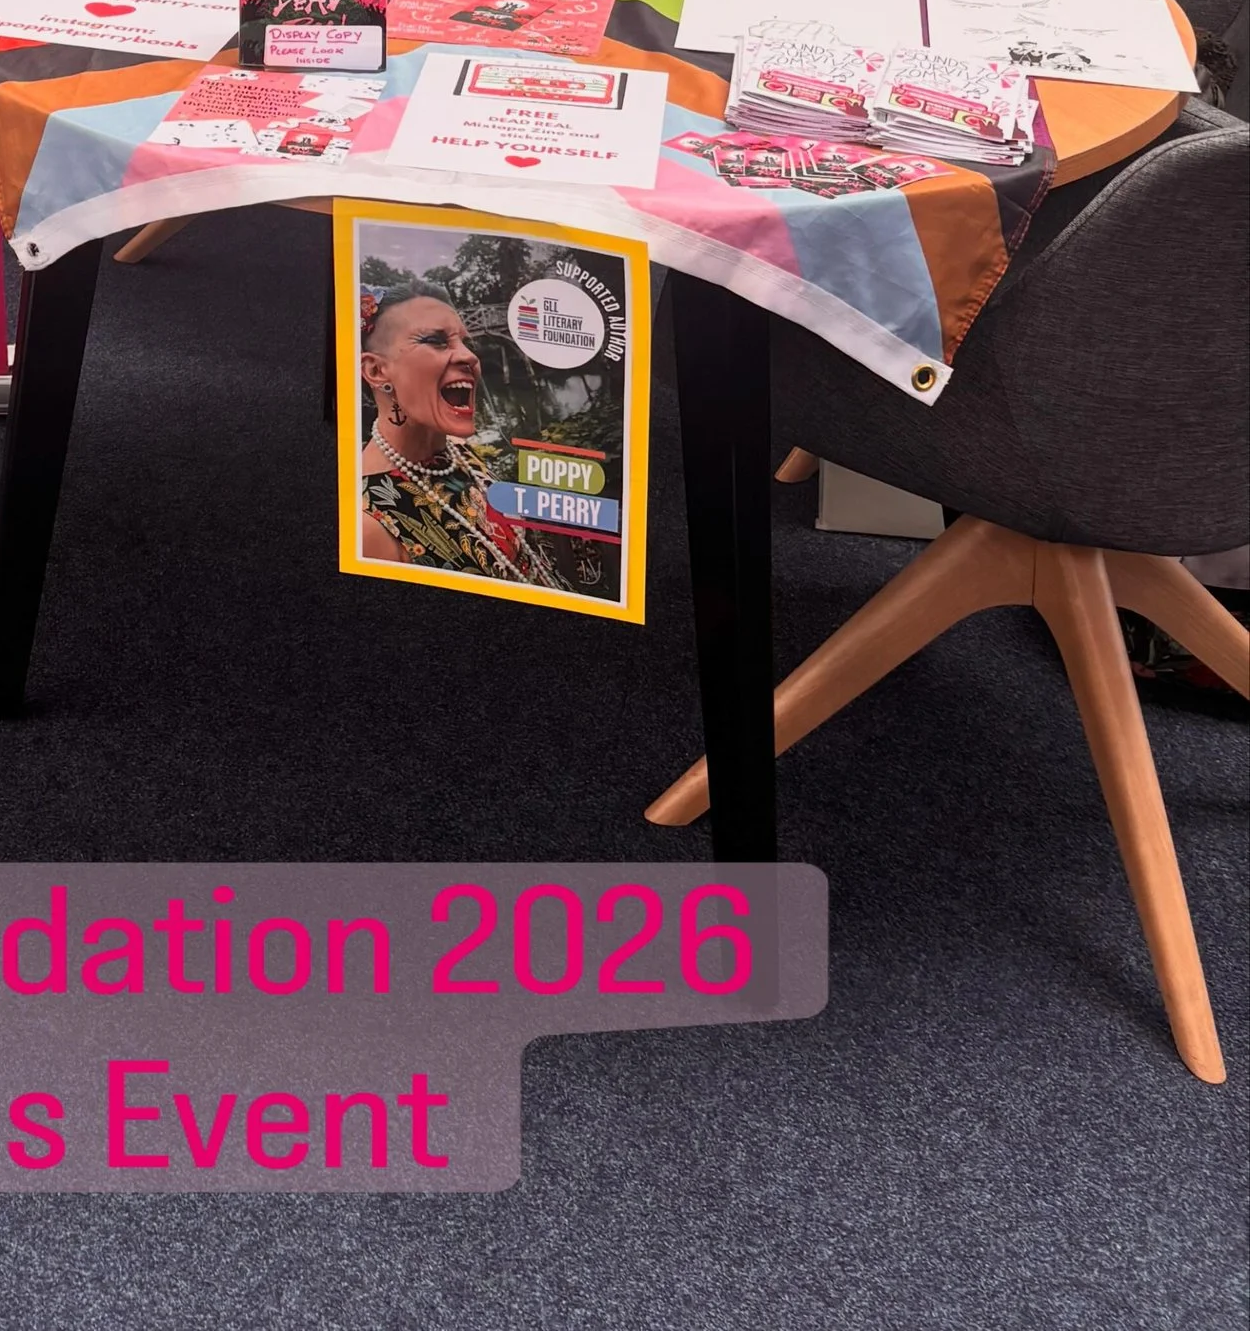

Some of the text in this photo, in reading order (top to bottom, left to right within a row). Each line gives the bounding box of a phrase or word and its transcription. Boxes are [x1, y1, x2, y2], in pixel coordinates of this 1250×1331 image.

[40, 14, 156, 36] instagram:
[269, 28, 363, 42] DISPLAY COPY
[270, 46, 344, 56] PLEASE LOOK
[506, 107, 559, 120] FREE
[463, 120, 600, 139] Mixtape Zine and
[488, 116, 573, 130] DEAD REAL
[500, 132, 559, 143] stickers
[432, 135, 620, 160] HELP YOURSELF
[543, 299, 558, 314] GLL
[556, 260, 626, 362] SUPPORTED AUTHOR
[543, 315, 582, 331] LITERARY
[543, 329, 594, 348] FOUNDATION
[527, 455, 593, 490] POPPY
[514, 488, 601, 525] T. PERRY
